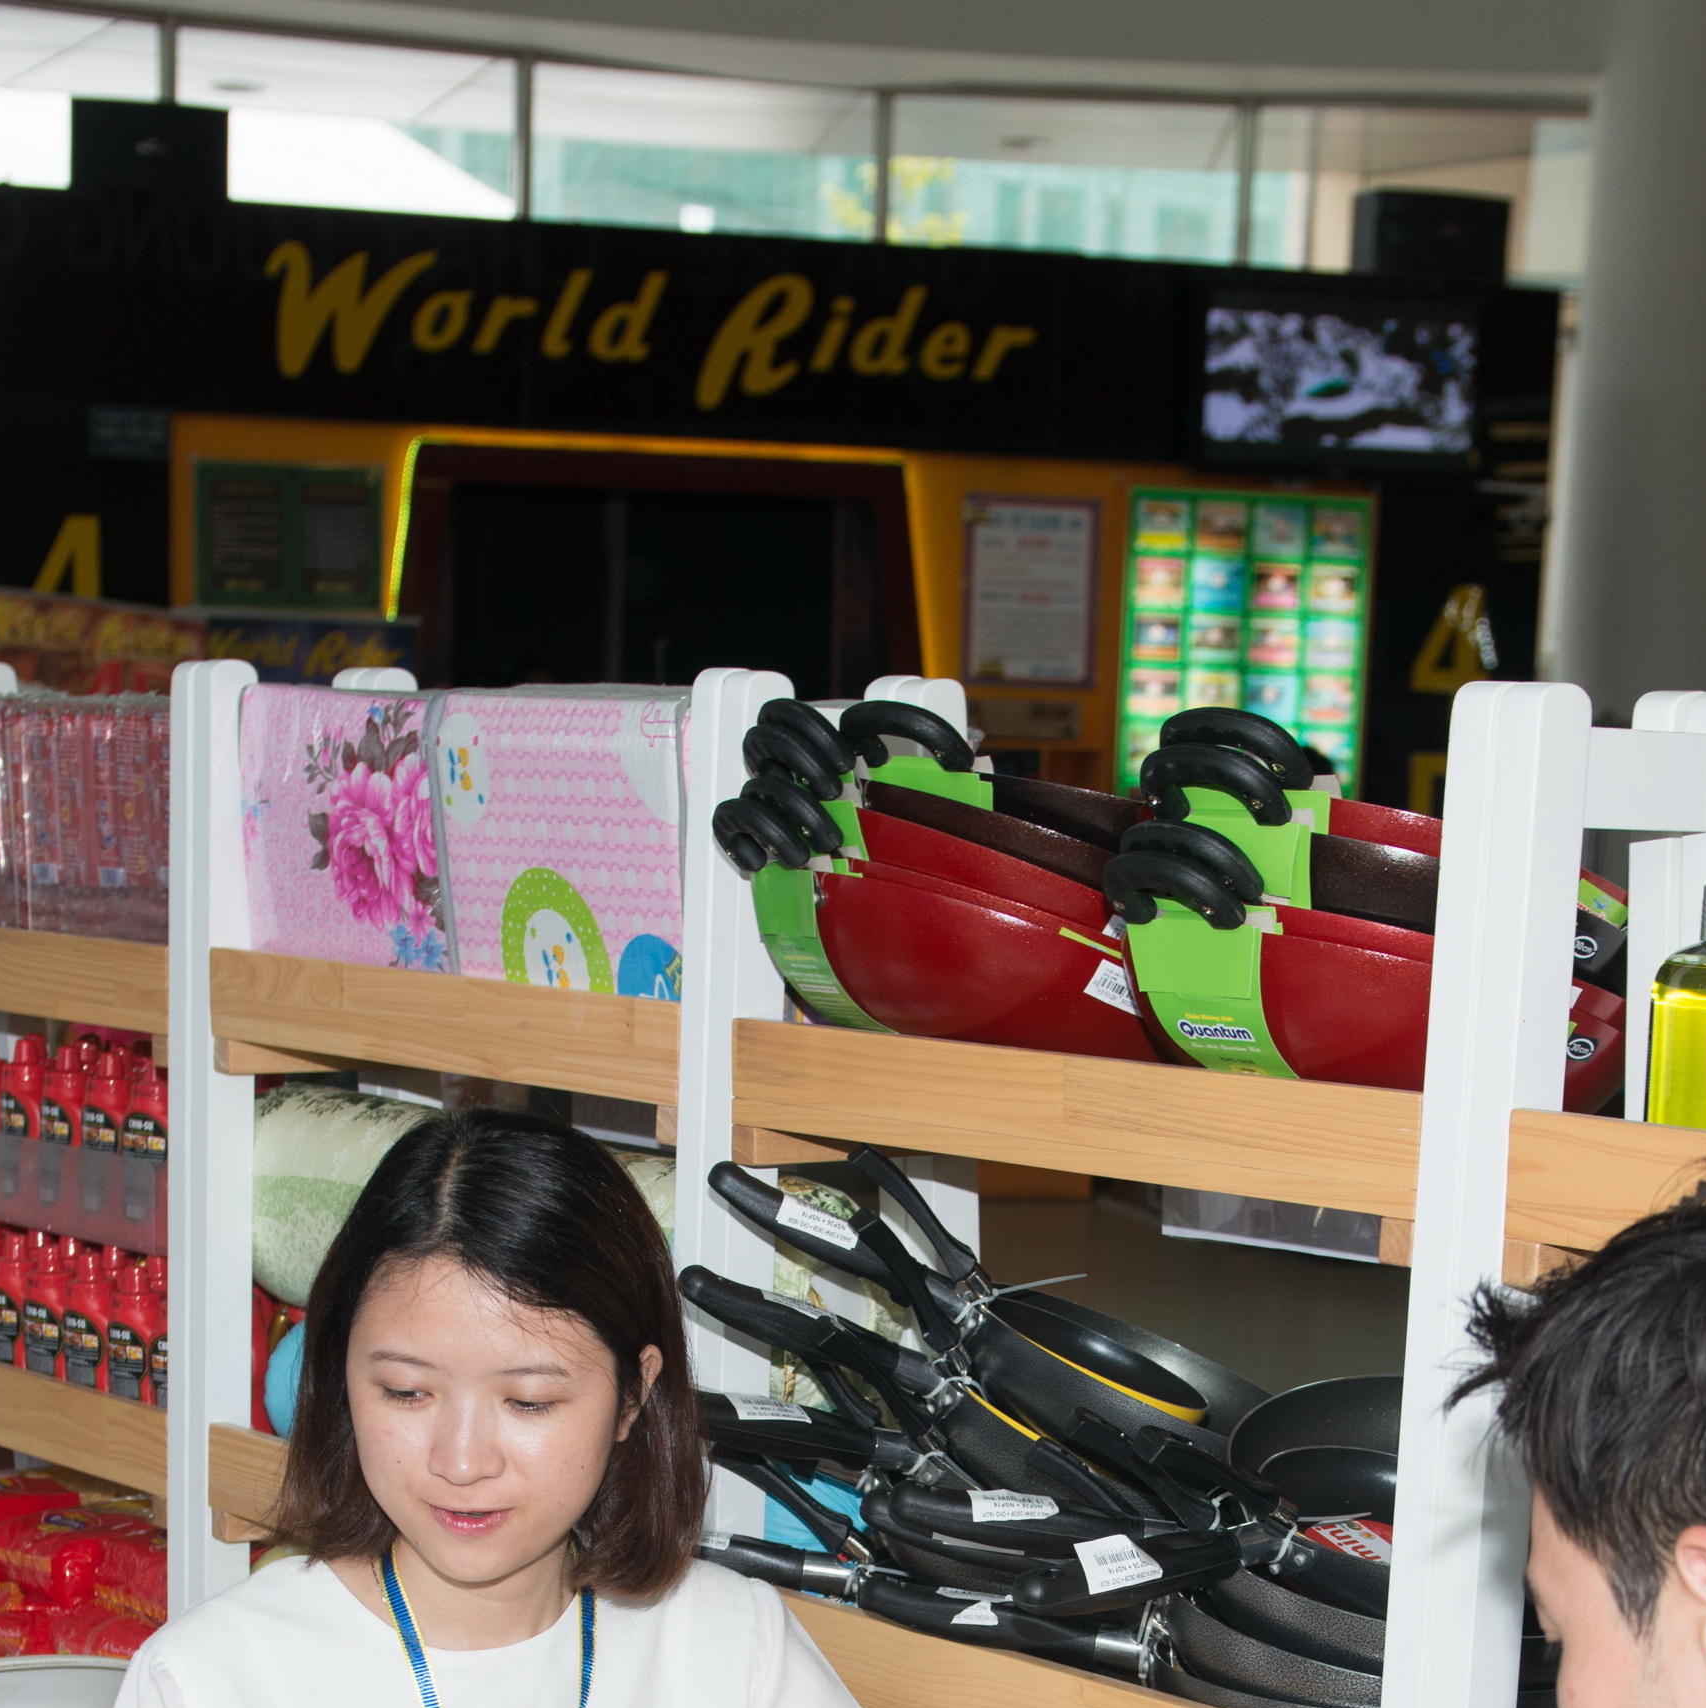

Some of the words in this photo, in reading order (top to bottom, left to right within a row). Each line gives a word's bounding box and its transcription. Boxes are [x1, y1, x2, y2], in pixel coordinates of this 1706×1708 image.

[263, 240, 668, 380] World
[695, 270, 1037, 410] Rider
[1178, 1020, 1254, 1041] Quantum
[1315, 1524, 1381, 1562] mini
